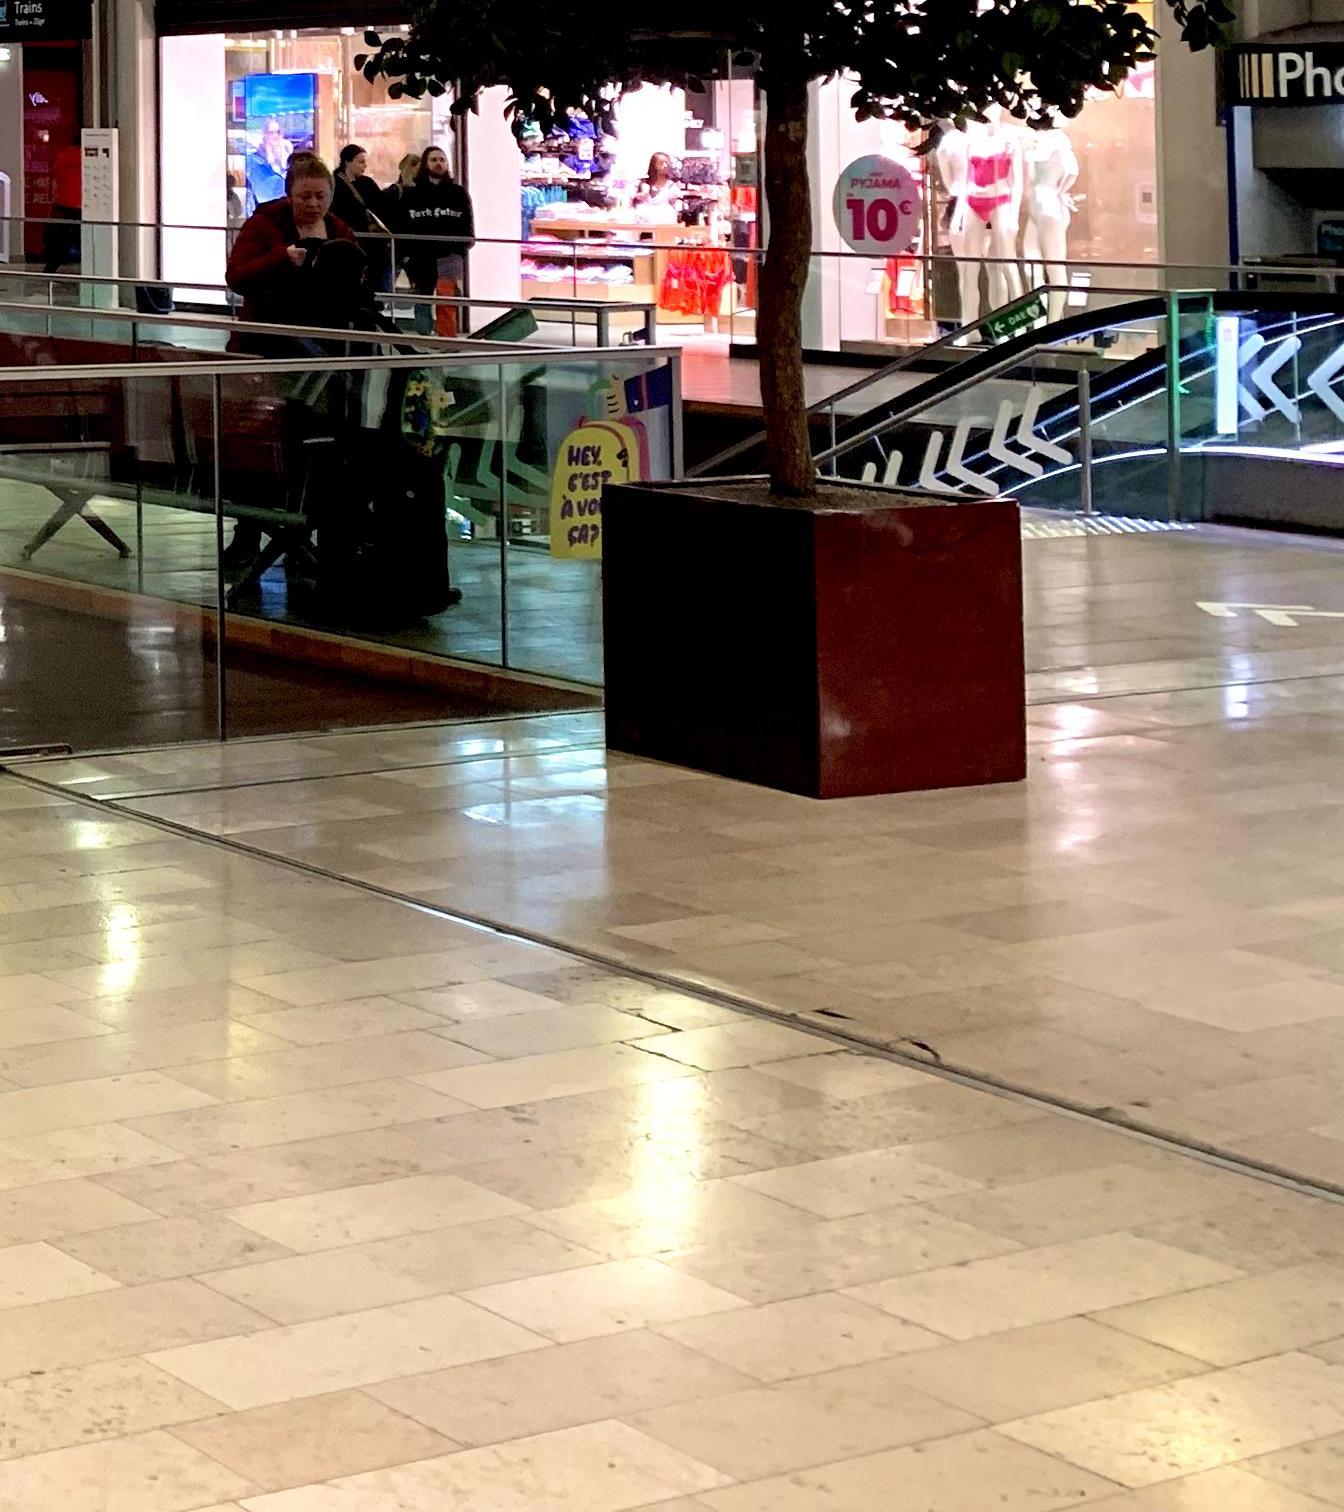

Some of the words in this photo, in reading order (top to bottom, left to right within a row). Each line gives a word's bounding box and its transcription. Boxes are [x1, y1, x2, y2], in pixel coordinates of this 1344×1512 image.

[14, 1, 43, 14] Trains
[850, 178, 901, 189] PYJAMA
[1008, 311, 1028, 326] DAE
[567, 470, 612, 492] C'EST
[560, 493, 574, 520] À
[567, 523, 600, 547] ÇA?
